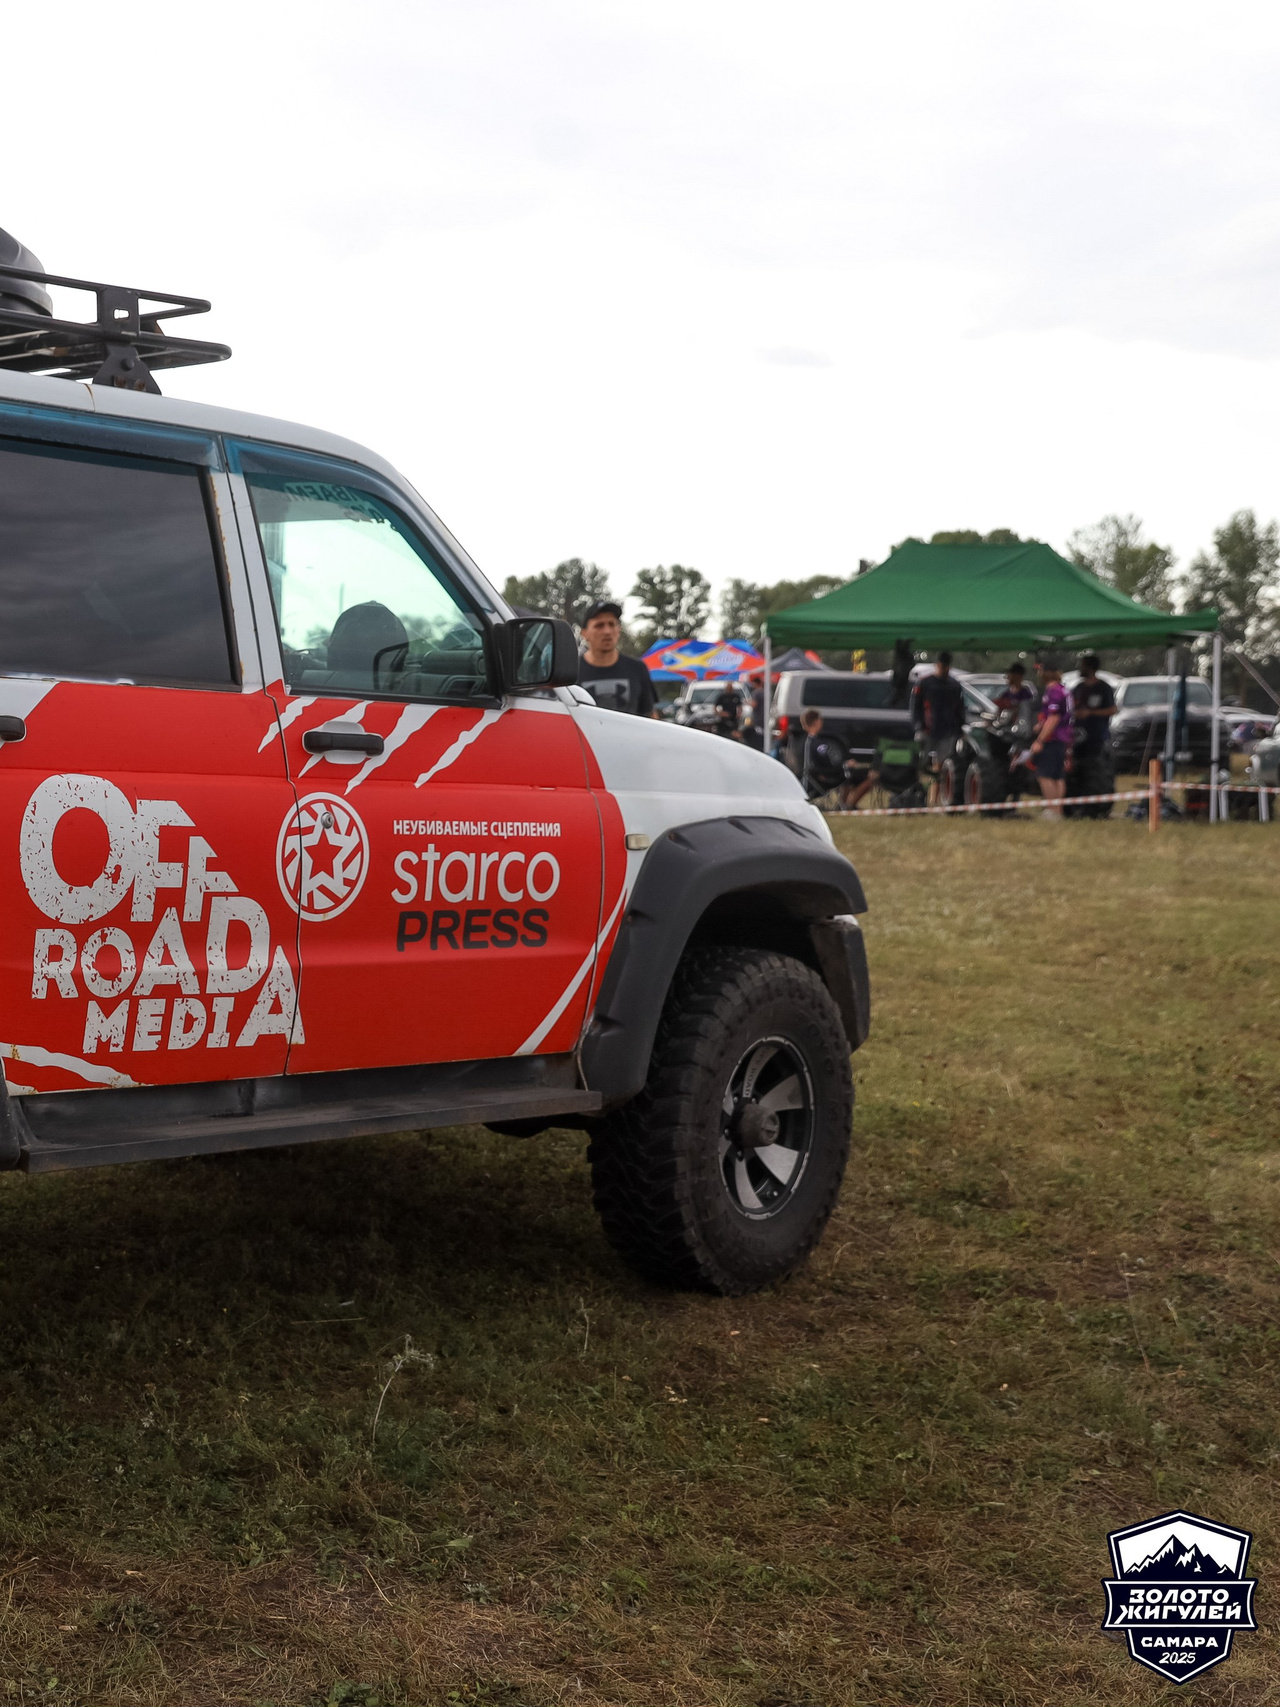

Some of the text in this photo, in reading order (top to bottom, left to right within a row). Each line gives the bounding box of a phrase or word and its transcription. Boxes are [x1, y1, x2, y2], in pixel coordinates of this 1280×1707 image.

[19, 773, 240, 925] OFF
[393, 819, 561, 839] НЕУБИВАЕМЫЕ СЦЕПЛЕНИЯ
[390, 843, 561, 904] starco
[31, 896, 270, 999] ROAD
[396, 908, 550, 952] PRESS
[82, 945, 306, 1054] MEDIA
